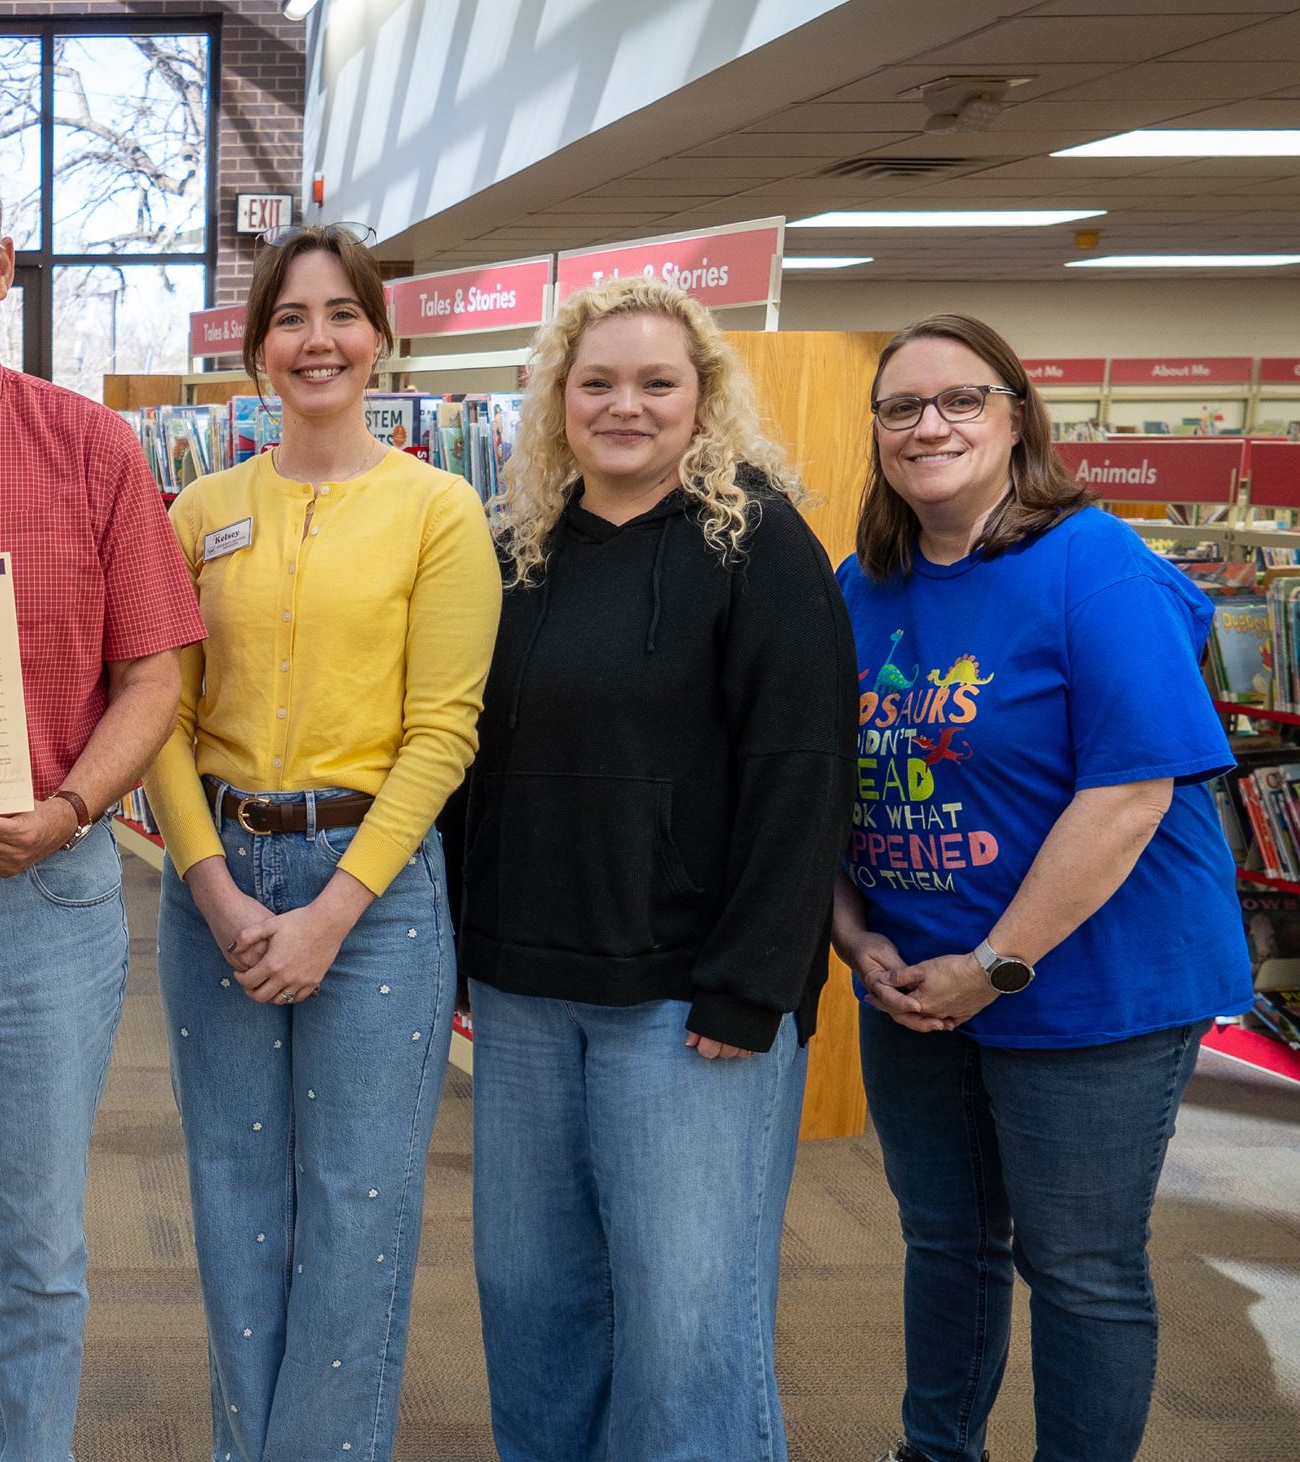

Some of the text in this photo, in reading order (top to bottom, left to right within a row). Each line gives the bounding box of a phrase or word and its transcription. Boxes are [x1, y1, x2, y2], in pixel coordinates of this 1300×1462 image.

[248, 198, 282, 228] EXIT
[661, 257, 729, 291] Stories
[419, 283, 516, 318] Tales & Stories
[203, 319, 247, 342] Tales & Stor
[1044, 364, 1064, 378] Me
[1151, 364, 1211, 377] About Me
[364, 410, 403, 428] STEM
[1074, 458, 1157, 485] Animals
[214, 530, 240, 544] Kelsey
[859, 685, 981, 728] OSAURS
[858, 728, 917, 756] IDN'T
[858, 757, 935, 801] EAD
[852, 802, 963, 830] OK WHAT
[852, 831, 999, 870] PPENED
[880, 870, 956, 893] THEM
